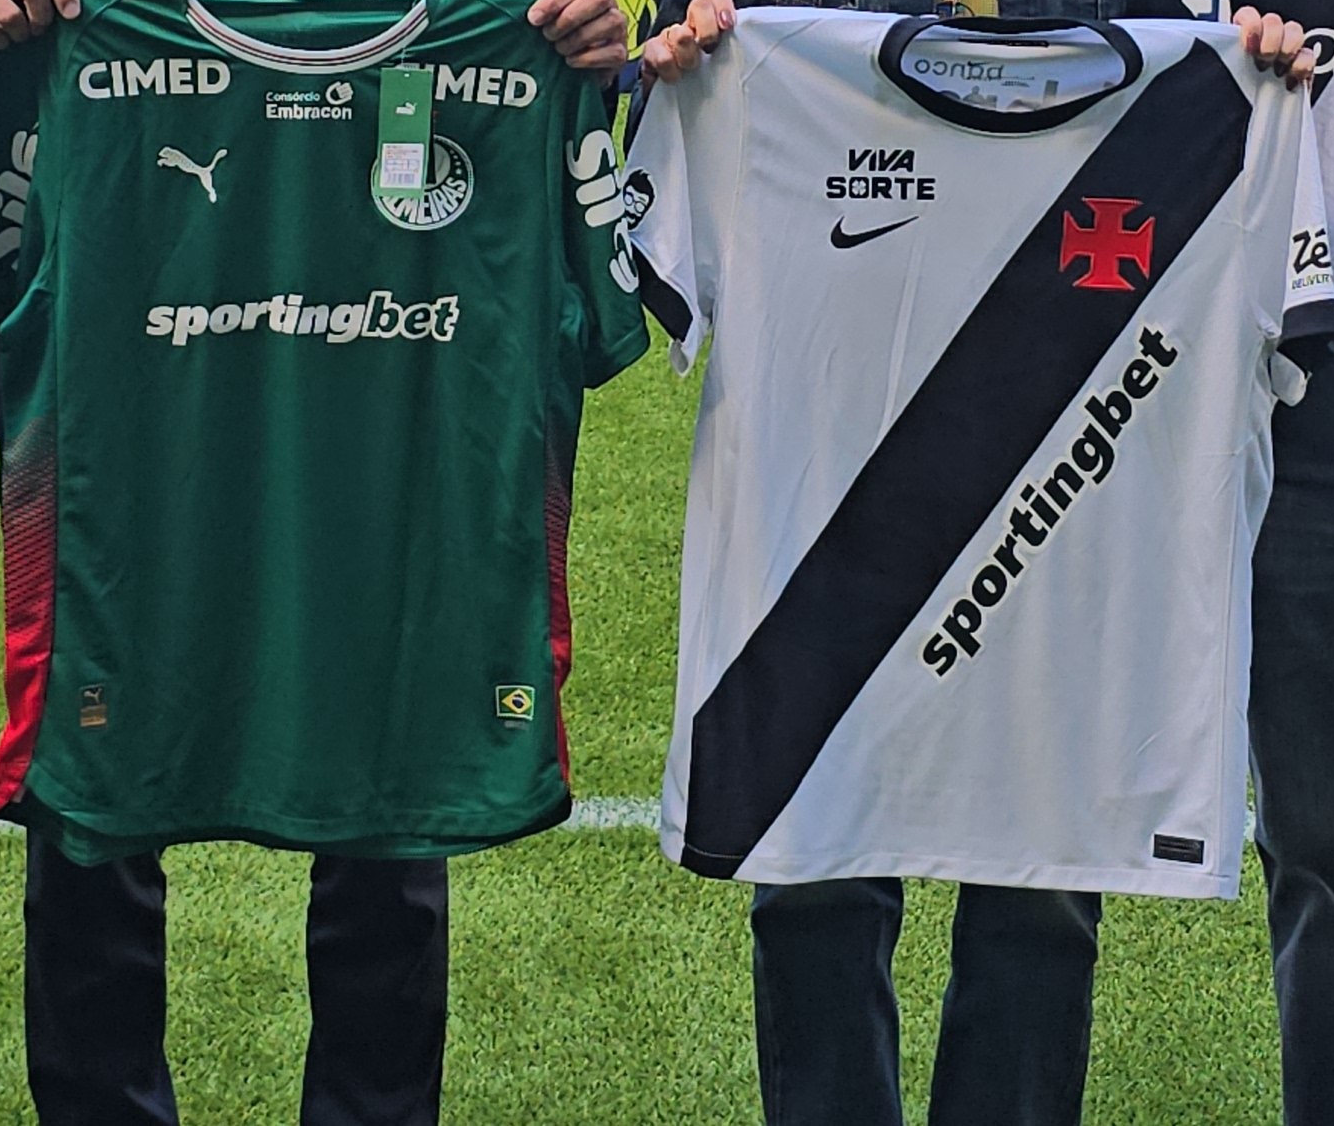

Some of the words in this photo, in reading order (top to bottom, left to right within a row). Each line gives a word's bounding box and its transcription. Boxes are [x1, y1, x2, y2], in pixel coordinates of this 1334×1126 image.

[79, 59, 231, 99] CIMED
[266, 90, 321, 103] Consórcio
[424, 64, 538, 108] MED
[266, 104, 353, 121] Embracon
[848, 149, 915, 173] VIVA
[826, 176, 936, 200] SORTE
[1292, 228, 1332, 274] Zé
[146, 290, 459, 346] sportingbet
[922, 326, 1179, 677] sportingbet
